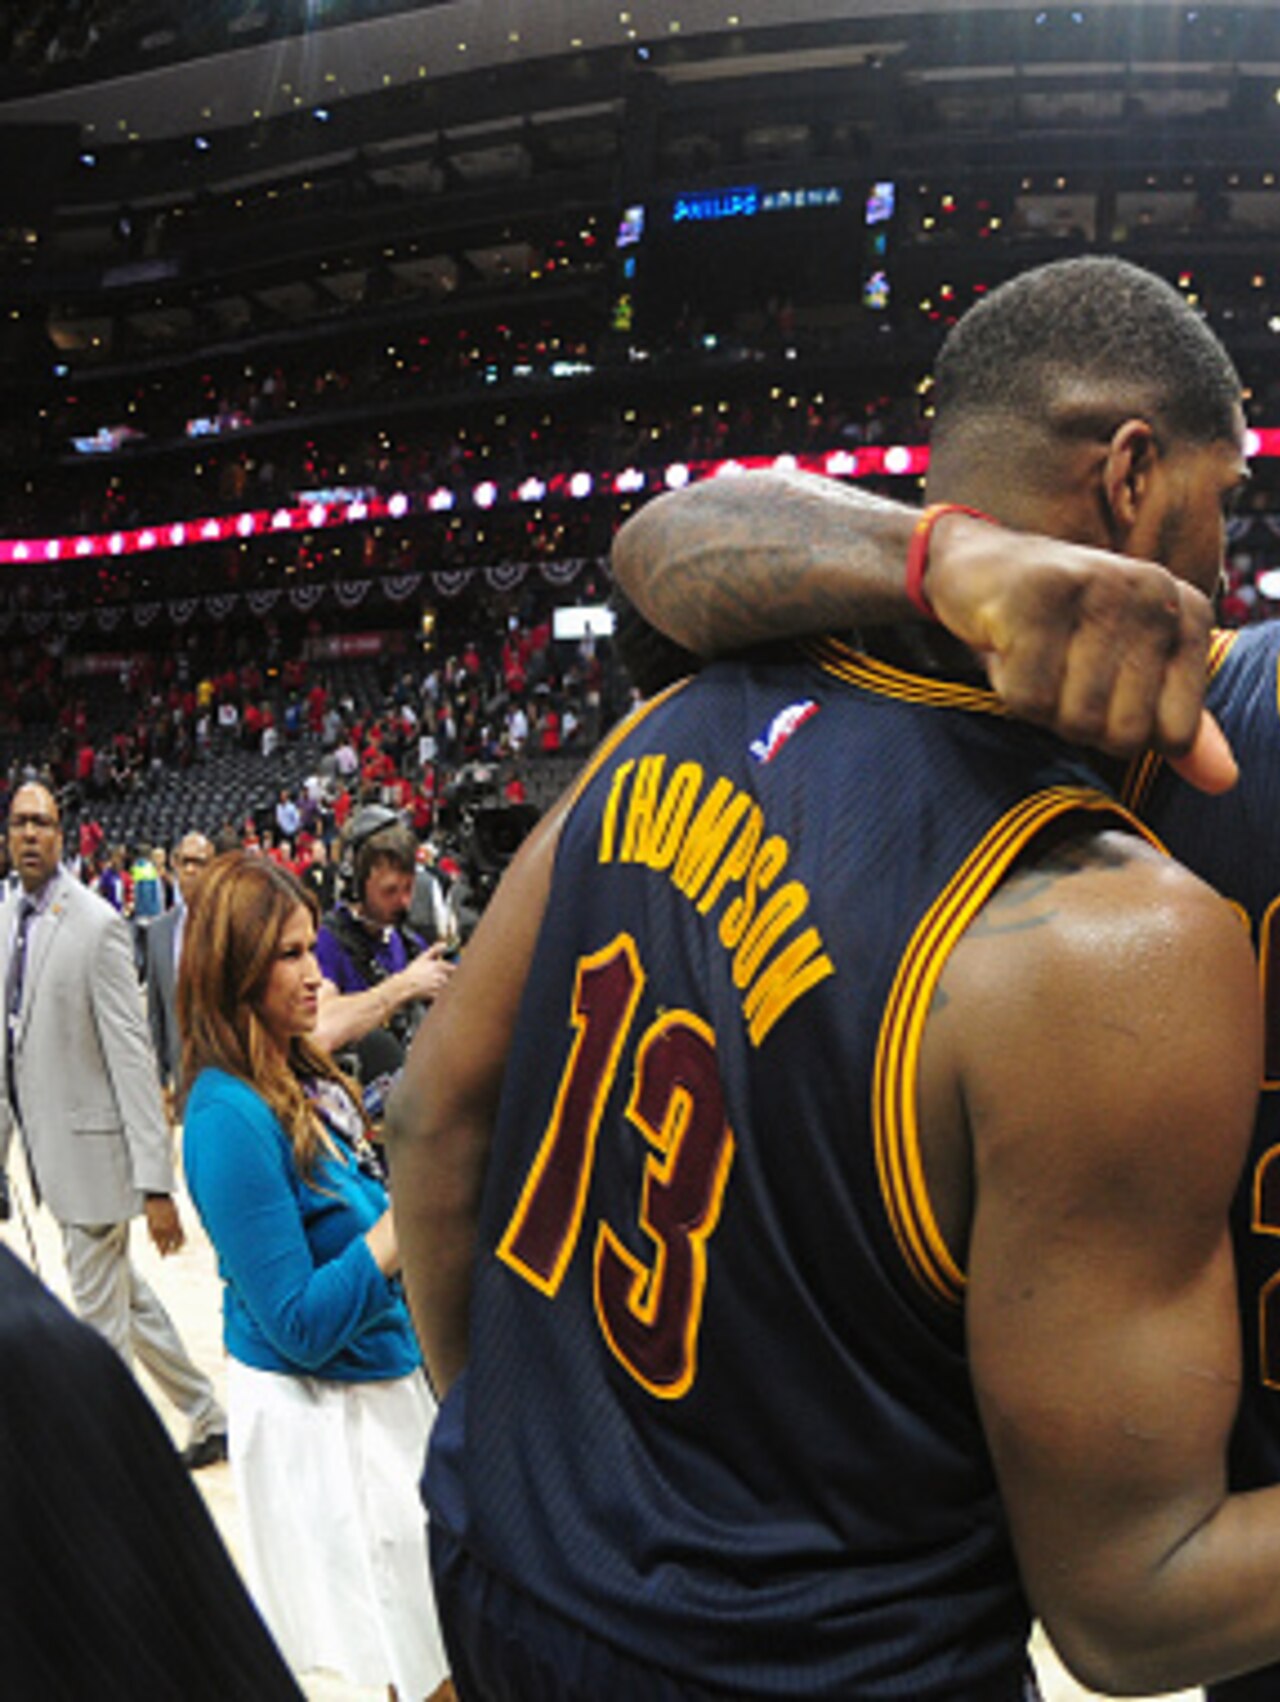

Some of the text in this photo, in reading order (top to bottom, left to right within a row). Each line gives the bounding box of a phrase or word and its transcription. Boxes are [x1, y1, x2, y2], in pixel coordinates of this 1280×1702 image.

[763, 187, 842, 209] ARENA
[598, 754, 836, 1048] THOMPSON
[496, 931, 735, 1400] 13
